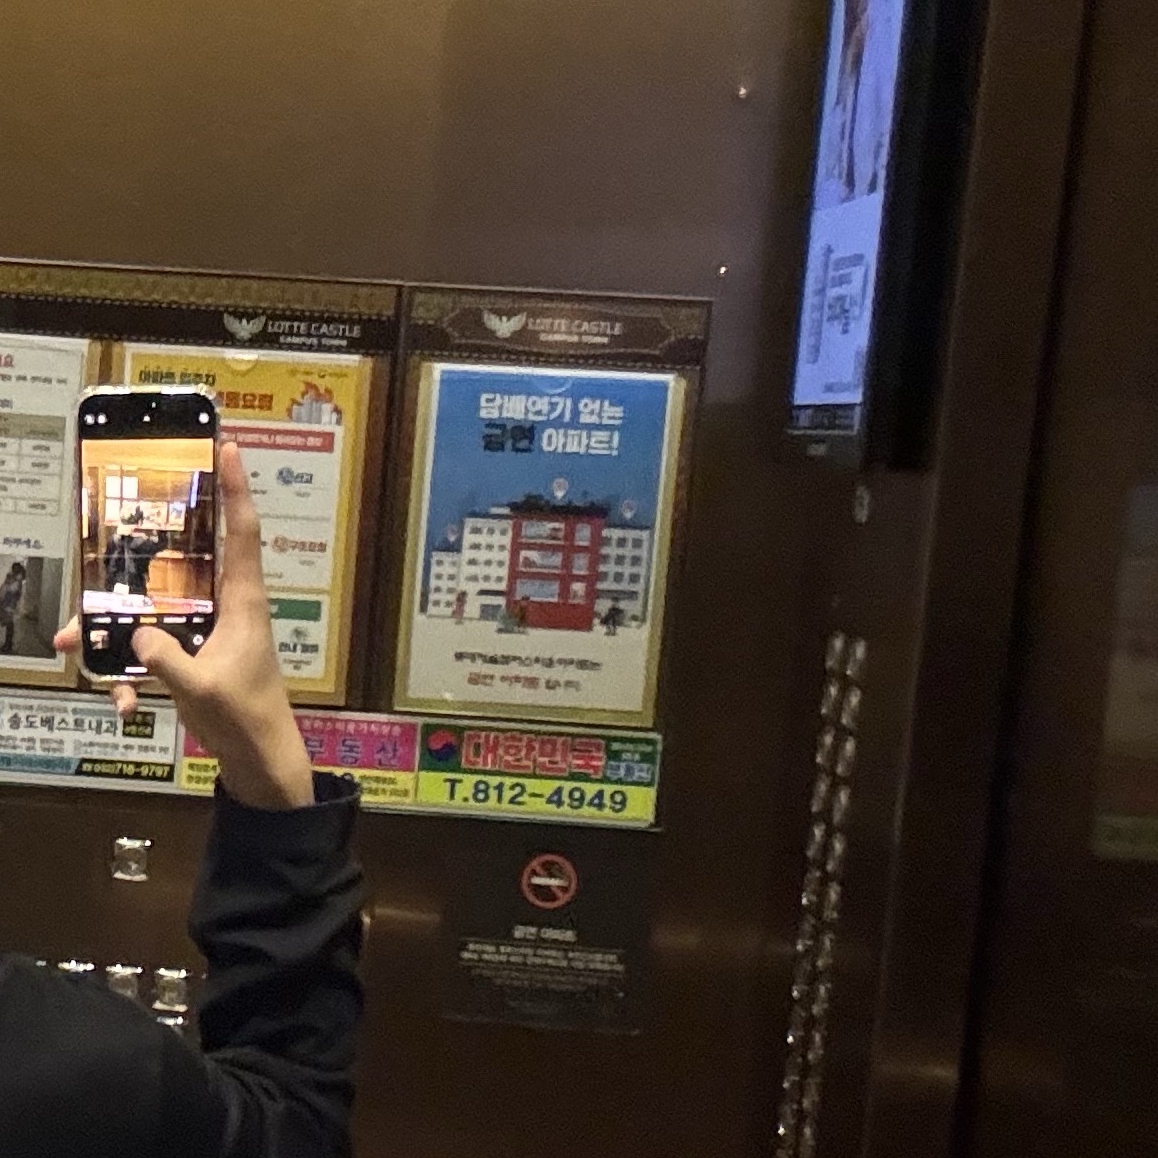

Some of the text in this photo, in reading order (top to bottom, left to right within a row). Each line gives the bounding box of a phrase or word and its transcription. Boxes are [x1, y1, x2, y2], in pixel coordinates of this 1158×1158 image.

[267, 320, 362, 338] LOTTE CASTLE
[479, 393, 625, 426] 담배연기 없는
[542, 428, 620, 457] 아파트!
[7, 712, 119, 738] 송도베스트내과
[461, 730, 607, 780] 대한민국
[444, 778, 629, 814] T.812-4949
